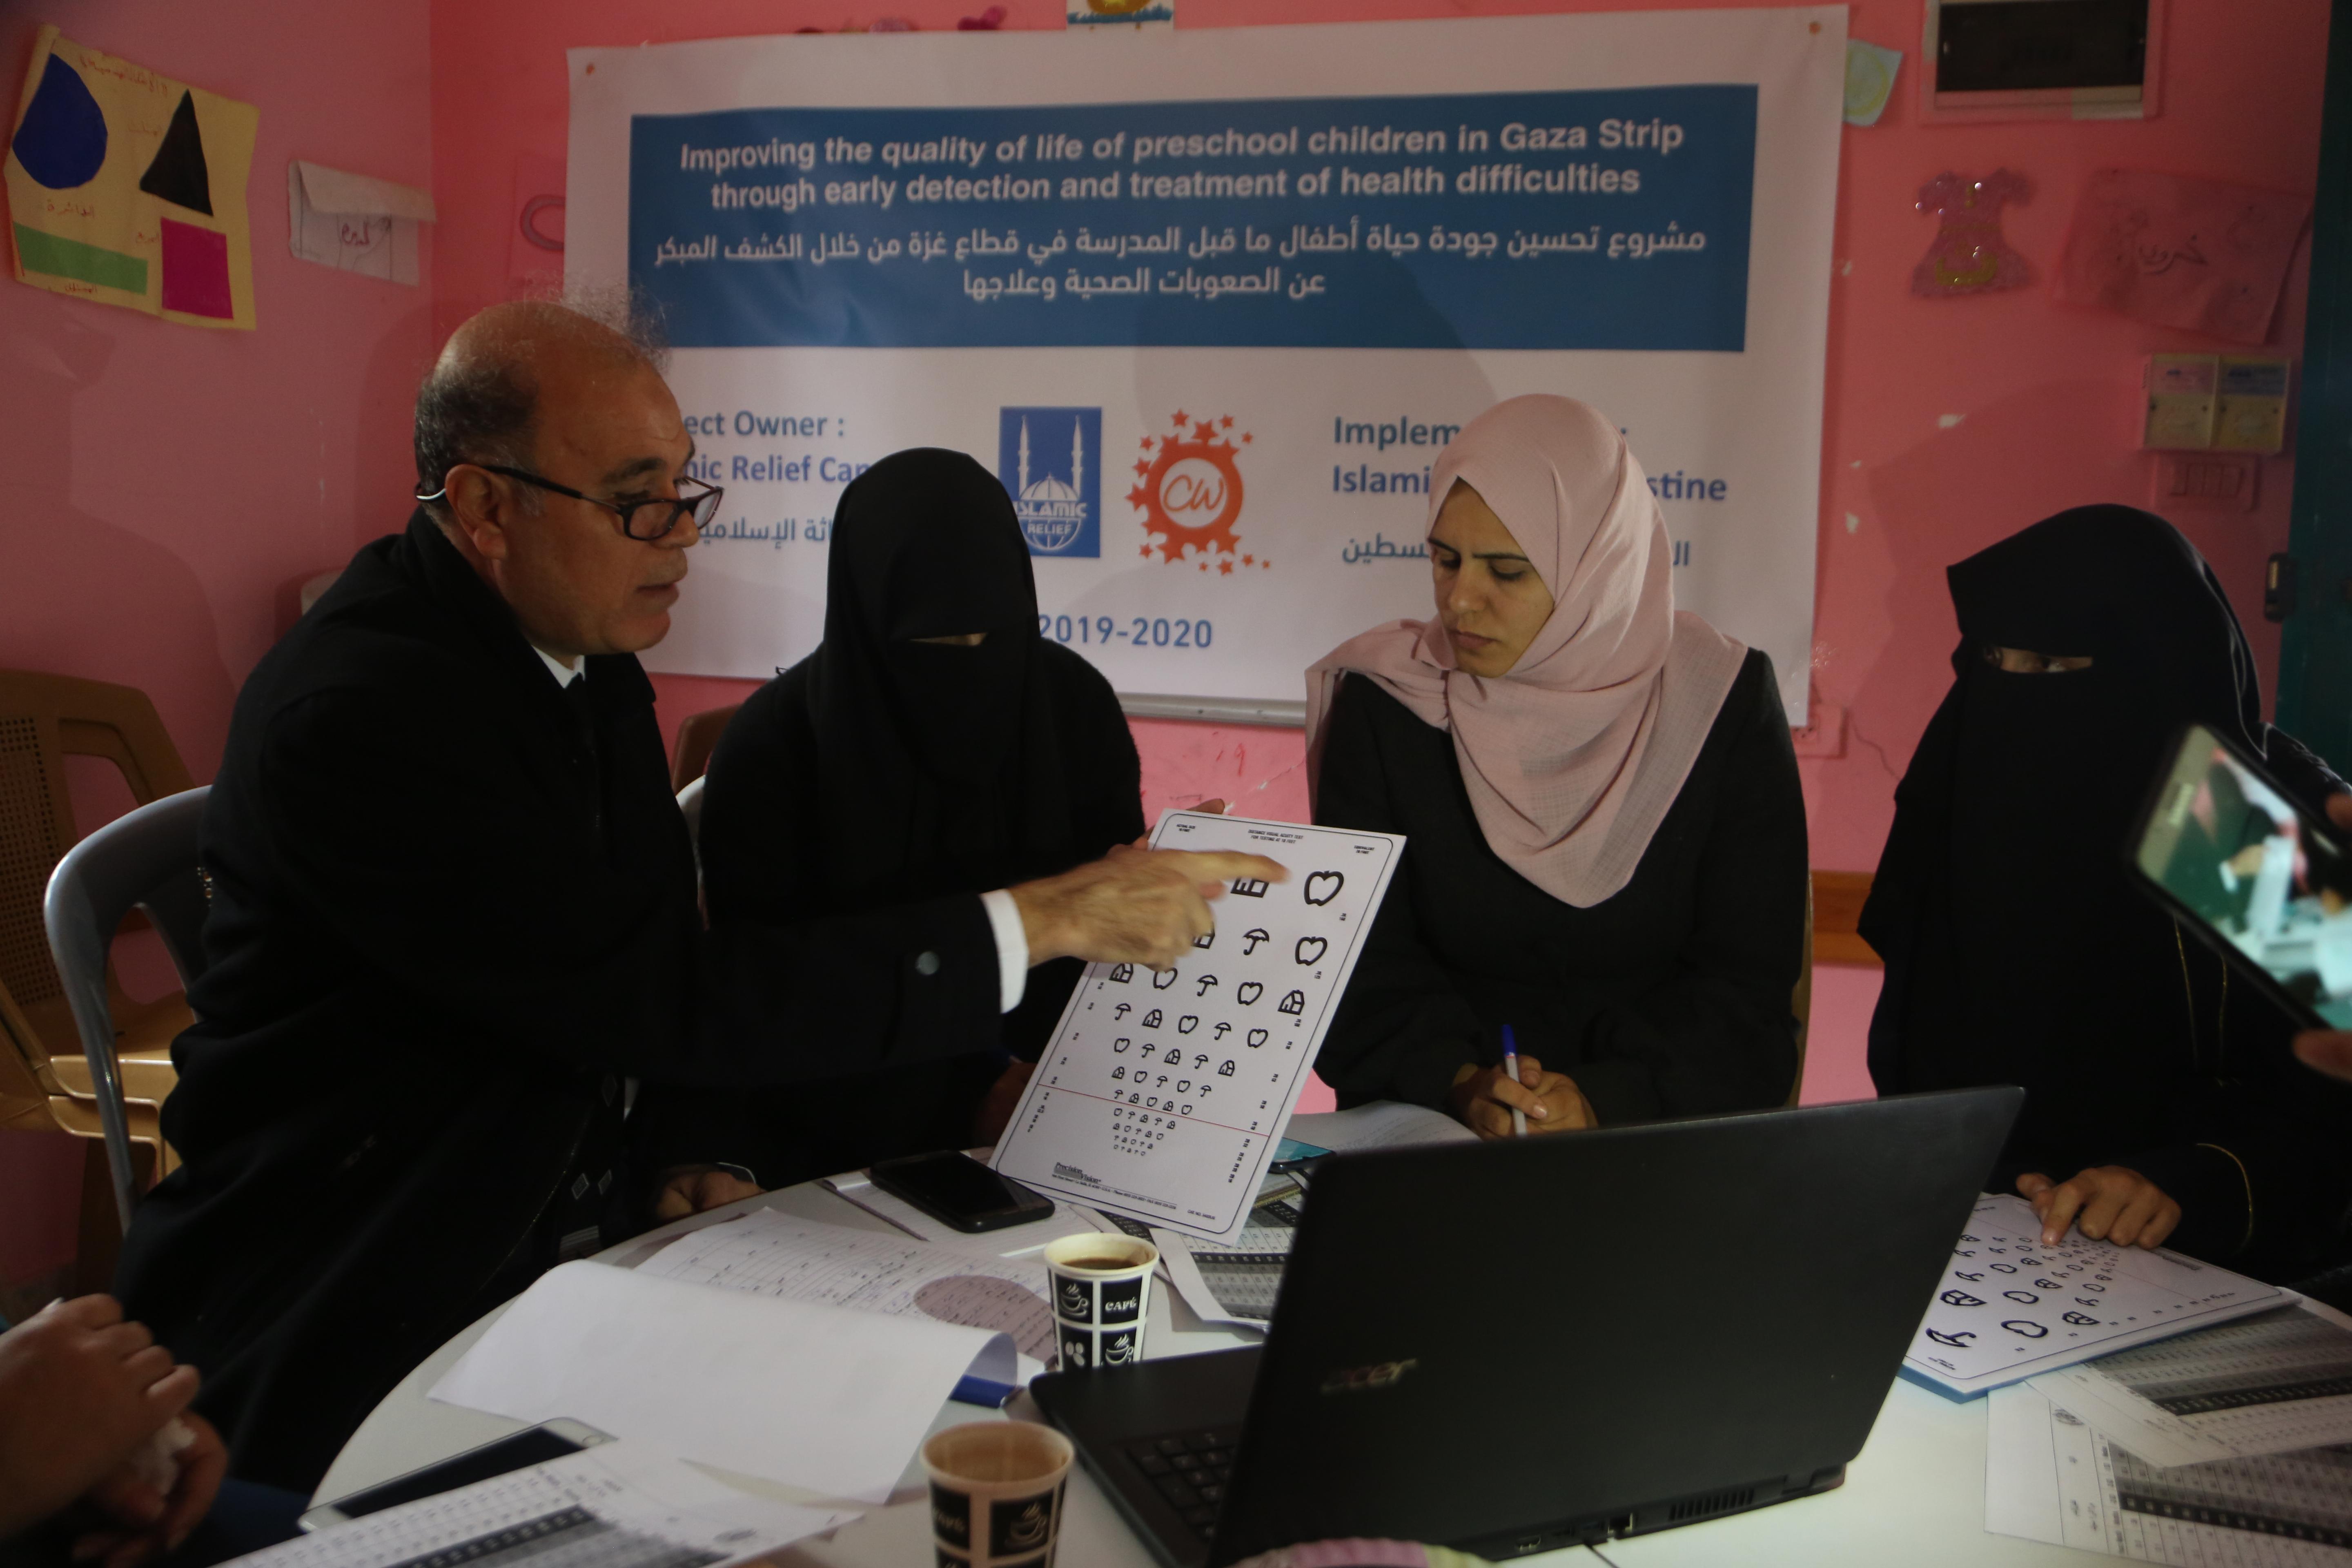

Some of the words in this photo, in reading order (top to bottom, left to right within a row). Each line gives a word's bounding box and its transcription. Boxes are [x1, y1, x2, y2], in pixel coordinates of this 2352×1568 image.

[680, 137, 816, 176] Improving
[824, 136, 873, 163] the
[881, 136, 987, 168] quality
[996, 134, 1027, 162] of
[1036, 134, 1084, 160] life
[1092, 131, 1125, 159] of
[1133, 127, 1298, 164] preschool
[1307, 125, 1446, 154] children
[1458, 124, 1489, 152] in
[1500, 122, 1587, 151] Gaza
[1599, 118, 1684, 155] Strip
[711, 176, 817, 213] through
[824, 175, 896, 209] early
[905, 173, 1050, 202] detection
[1060, 171, 1120, 199] and
[1129, 169, 1287, 198] treatment
[1297, 166, 1331, 196] of
[1341, 166, 1445, 195] health
[1455, 163, 1640, 194] difficulties
[655, 235, 718, 267] المبكر
[724, 233, 804, 261] الكشف
[810, 232, 860, 266] خلال
[866, 237, 902, 264] من
[908, 231, 947, 262] غزة
[954, 228, 1020, 262] قطاع
[1026, 229, 1068, 266] في
[1075, 226, 1181, 258] المدرسة
[1187, 226, 1237, 259] قبل
[1245, 225, 1272, 252] ما
[1278, 215, 1359, 258] أطفال
[1366, 223, 1421, 257] حياة
[1428, 225, 1498, 258] جودة
[1506, 226, 1600, 258] تحسين
[1607, 220, 1706, 258] مشروع
[963, 268, 1057, 302] وعلاجها
[1064, 267, 1151, 299] الصحية
[1158, 266, 1280, 299] الصعوبات
[1288, 273, 1325, 300] عن
[733, 410, 827, 437] Owner
[1334, 415, 1461, 451] Implem
[732, 454, 811, 481] Relief
[819, 456, 872, 482] Can
[1332, 464, 1430, 493] Islami
[1646, 470, 1727, 501] stine
[699, 517, 796, 549] الإسلامي
[1027, 523, 1072, 535] RELIEF
[1342, 532, 1430, 564] سطين
[1038, 614, 1212, 648] 2019-2020
[1056, 1162, 1083, 1174] Precision
[1105, 1296, 1137, 1312] CAFÉ
